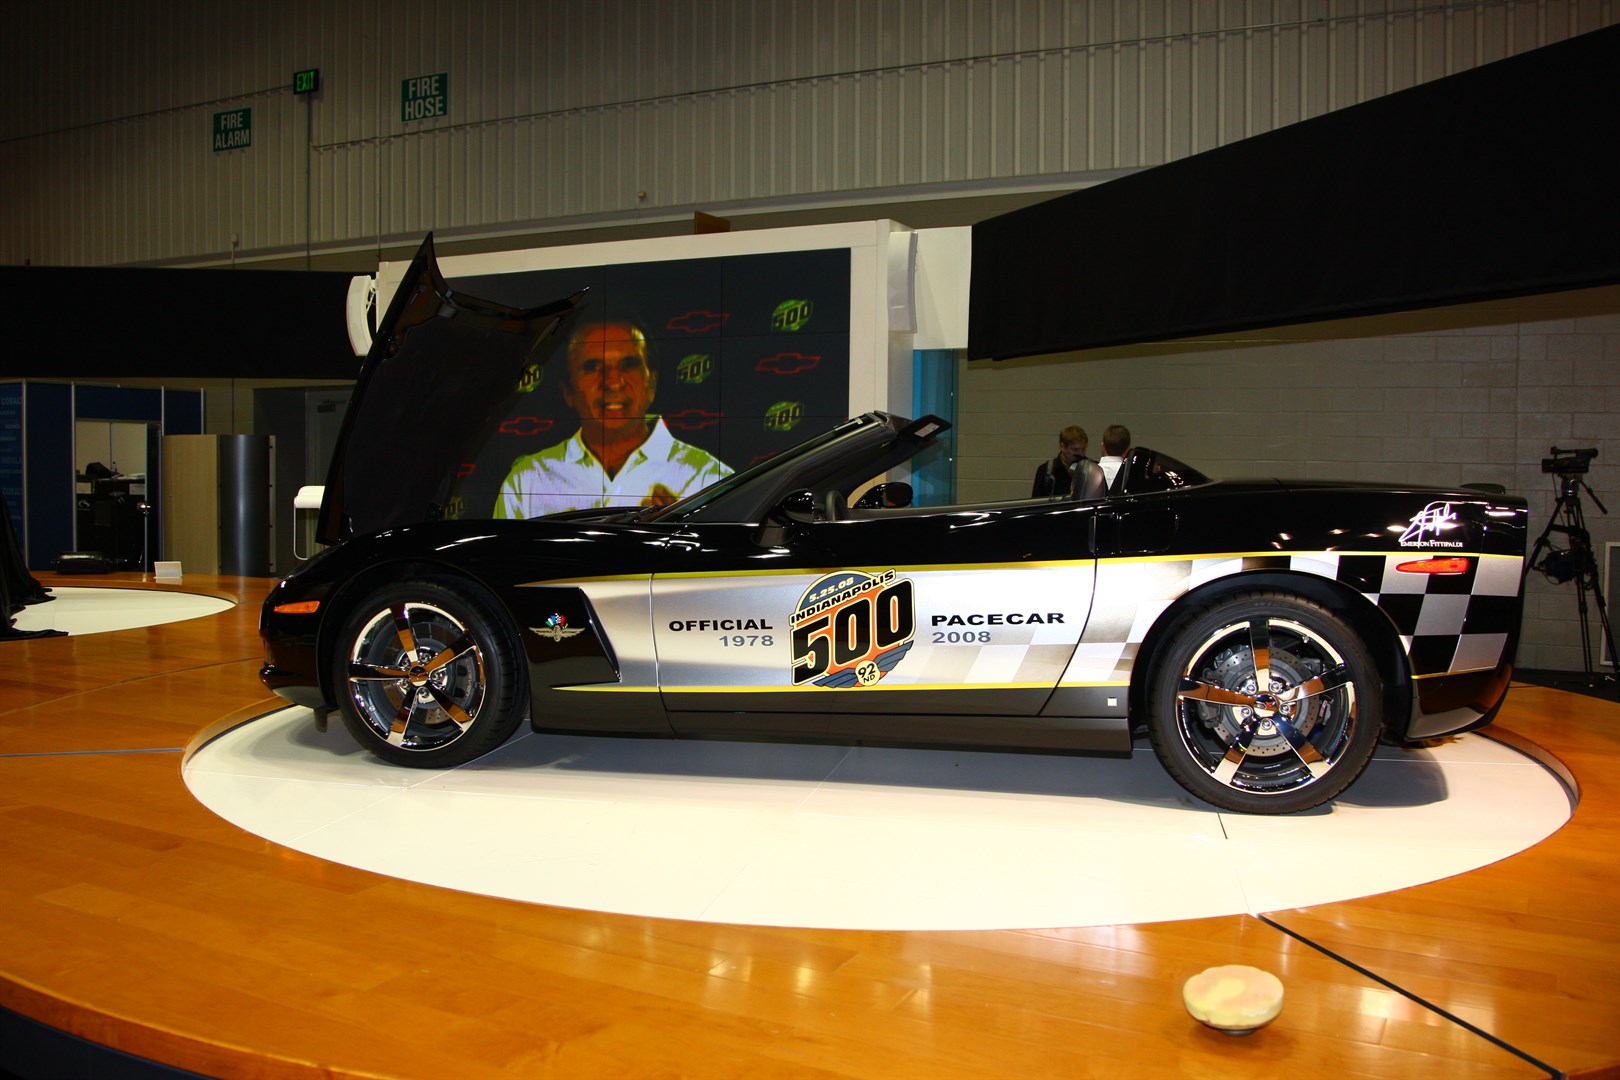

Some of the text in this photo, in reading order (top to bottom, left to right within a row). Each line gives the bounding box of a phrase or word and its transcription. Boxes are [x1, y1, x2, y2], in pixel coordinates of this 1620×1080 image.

[296, 72, 315, 91] EXIT
[408, 76, 439, 99] FIRE
[404, 96, 443, 120] HOSE
[220, 112, 243, 130] FIRE
[215, 128, 249, 149] ALARM
[772, 303, 813, 331] 500
[677, 357, 714, 384] 500
[764, 403, 804, 431] 500
[790, 571, 894, 624] INDIANAPOLIS
[809, 577, 854, 602] 5.25.08
[668, 619, 773, 631] OFFICIAL
[931, 613, 1065, 626] PACECAR
[719, 635, 774, 647] 1978
[792, 580, 914, 684] 500
[932, 631, 991, 643] 2008
[857, 663, 876, 678] 92
[863, 673, 876, 683] ND
